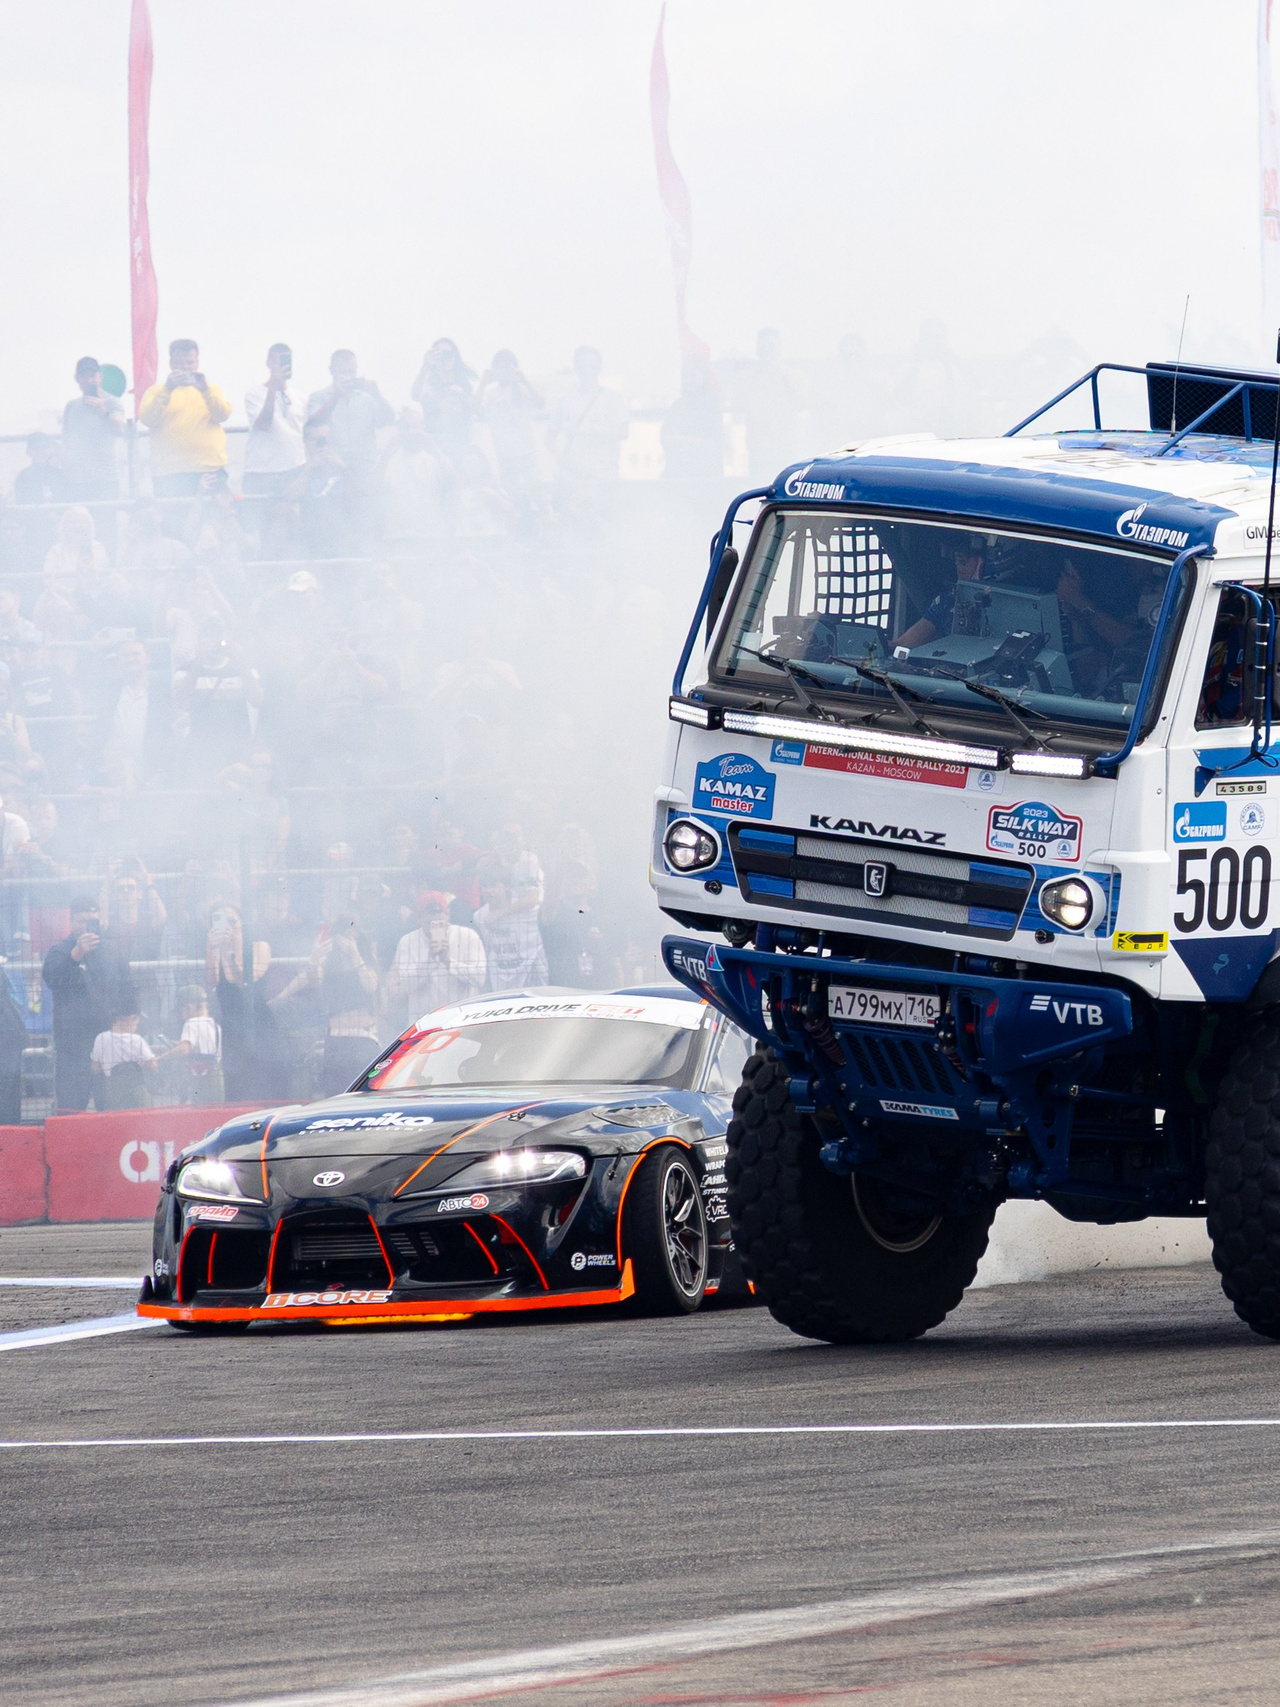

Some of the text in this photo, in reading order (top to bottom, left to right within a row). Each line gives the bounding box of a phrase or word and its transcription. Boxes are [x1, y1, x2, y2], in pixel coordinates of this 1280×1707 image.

[799, 481, 845, 500] ГАЗПРОМ
[1134, 523, 1189, 548] ГАЗПРОМ
[718, 756, 754, 778] Team
[846, 762, 875, 774] KAZAN
[883, 768, 922, 780] MOSCOW
[876, 754, 894, 765] SILK
[896, 757, 915, 768] WAY
[917, 759, 943, 772] RALLY
[945, 763, 966, 775] 2023
[699, 777, 768, 801] KAMAZ
[1220, 785, 1264, 793] 43509
[711, 796, 753, 813] master
[1023, 808, 1049, 818] 2023
[810, 814, 947, 847] KAMAZ
[996, 815, 1075, 836] SILK WAY
[1189, 824, 1224, 838] GAZPROM
[1018, 832, 1049, 841] RALLY
[1018, 842, 1046, 858] 500
[1173, 845, 1272, 933] 500
[683, 956, 707, 980] VTB
[515, 1004, 582, 1014] DRIVE
[907, 996, 935, 1017] 716
[1052, 1001, 1104, 1026] VTB
[306, 1112, 434, 1130] seniko
